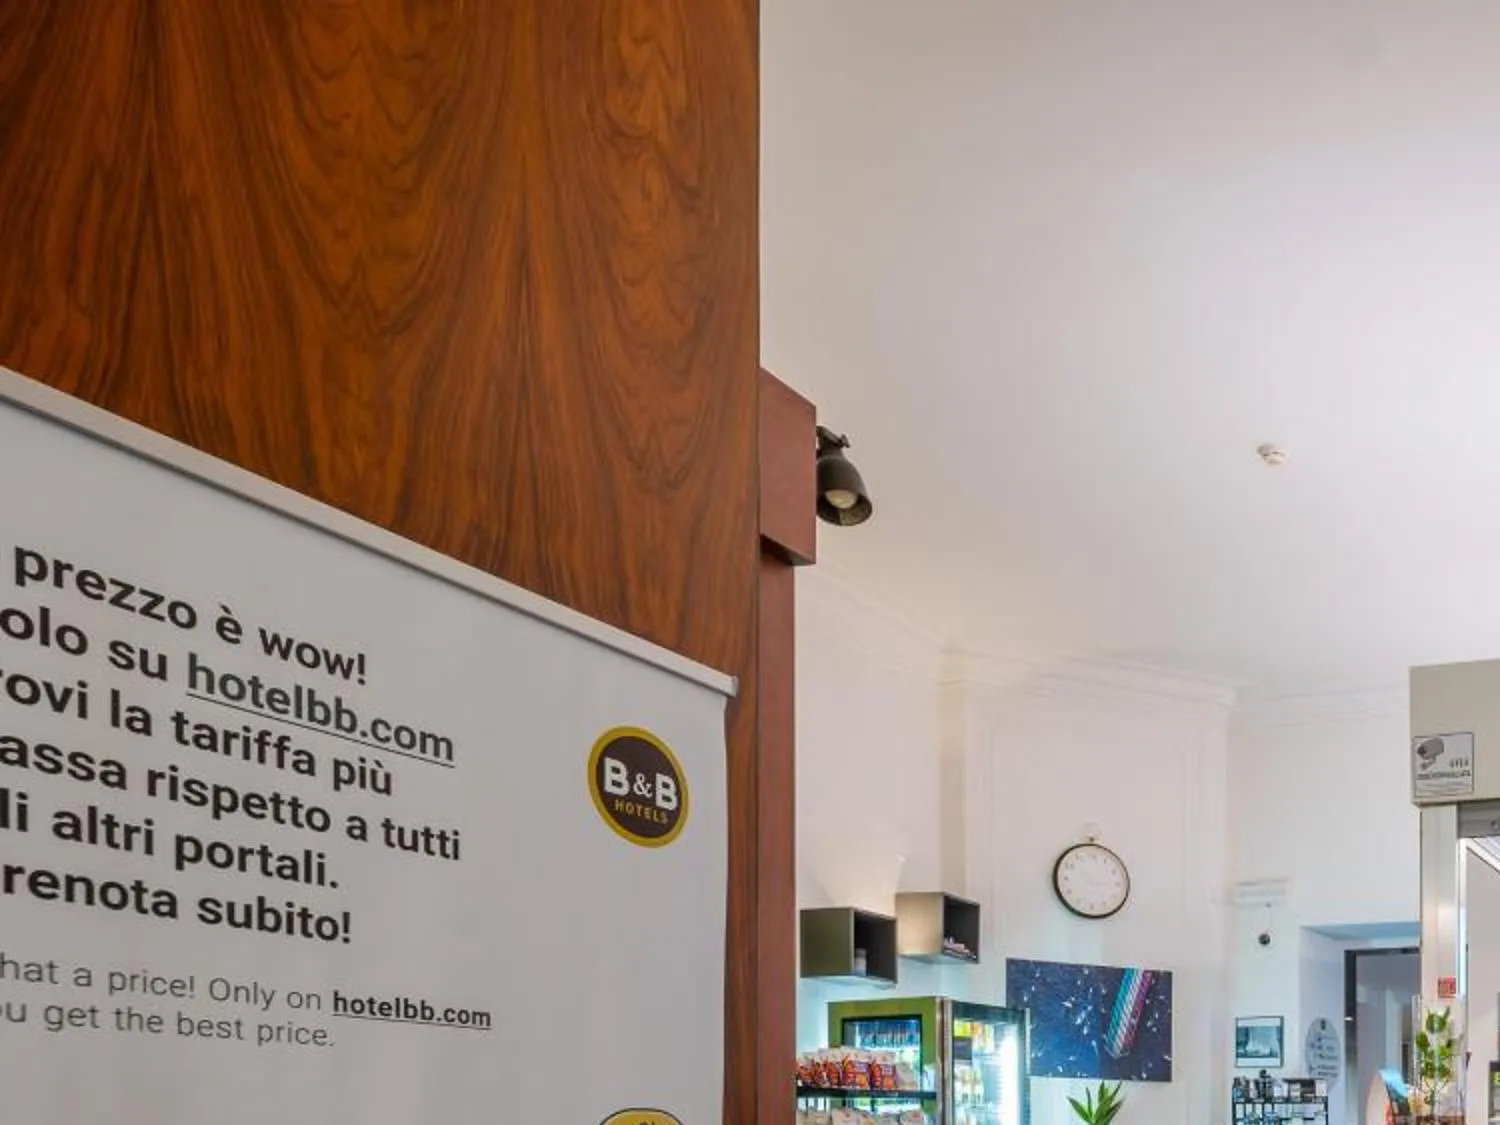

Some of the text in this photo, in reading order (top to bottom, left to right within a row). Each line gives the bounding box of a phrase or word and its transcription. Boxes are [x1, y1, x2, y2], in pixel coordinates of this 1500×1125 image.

[15, 546, 366, 685] prezzo è wow!
[0, 669, 392, 796] ovi la tariffa più
[108, 640, 167, 681] su
[187, 652, 454, 764] hotelbb.com
[147, 764, 331, 834] rispetto
[346, 814, 368, 842] a
[381, 817, 460, 861] tutti
[604, 757, 678, 812] B&B
[615, 799, 668, 825] HOTELS
[52, 805, 154, 856] altri
[175, 834, 339, 889] portali.
[197, 896, 350, 944] subito!
[0, 1003, 335, 1047] u get the best price.
[73, 967, 92, 988] a
[108, 969, 195, 998] price!
[209, 977, 276, 1012] Only
[287, 991, 321, 1011] on
[332, 990, 492, 1029] hotelbb.com
